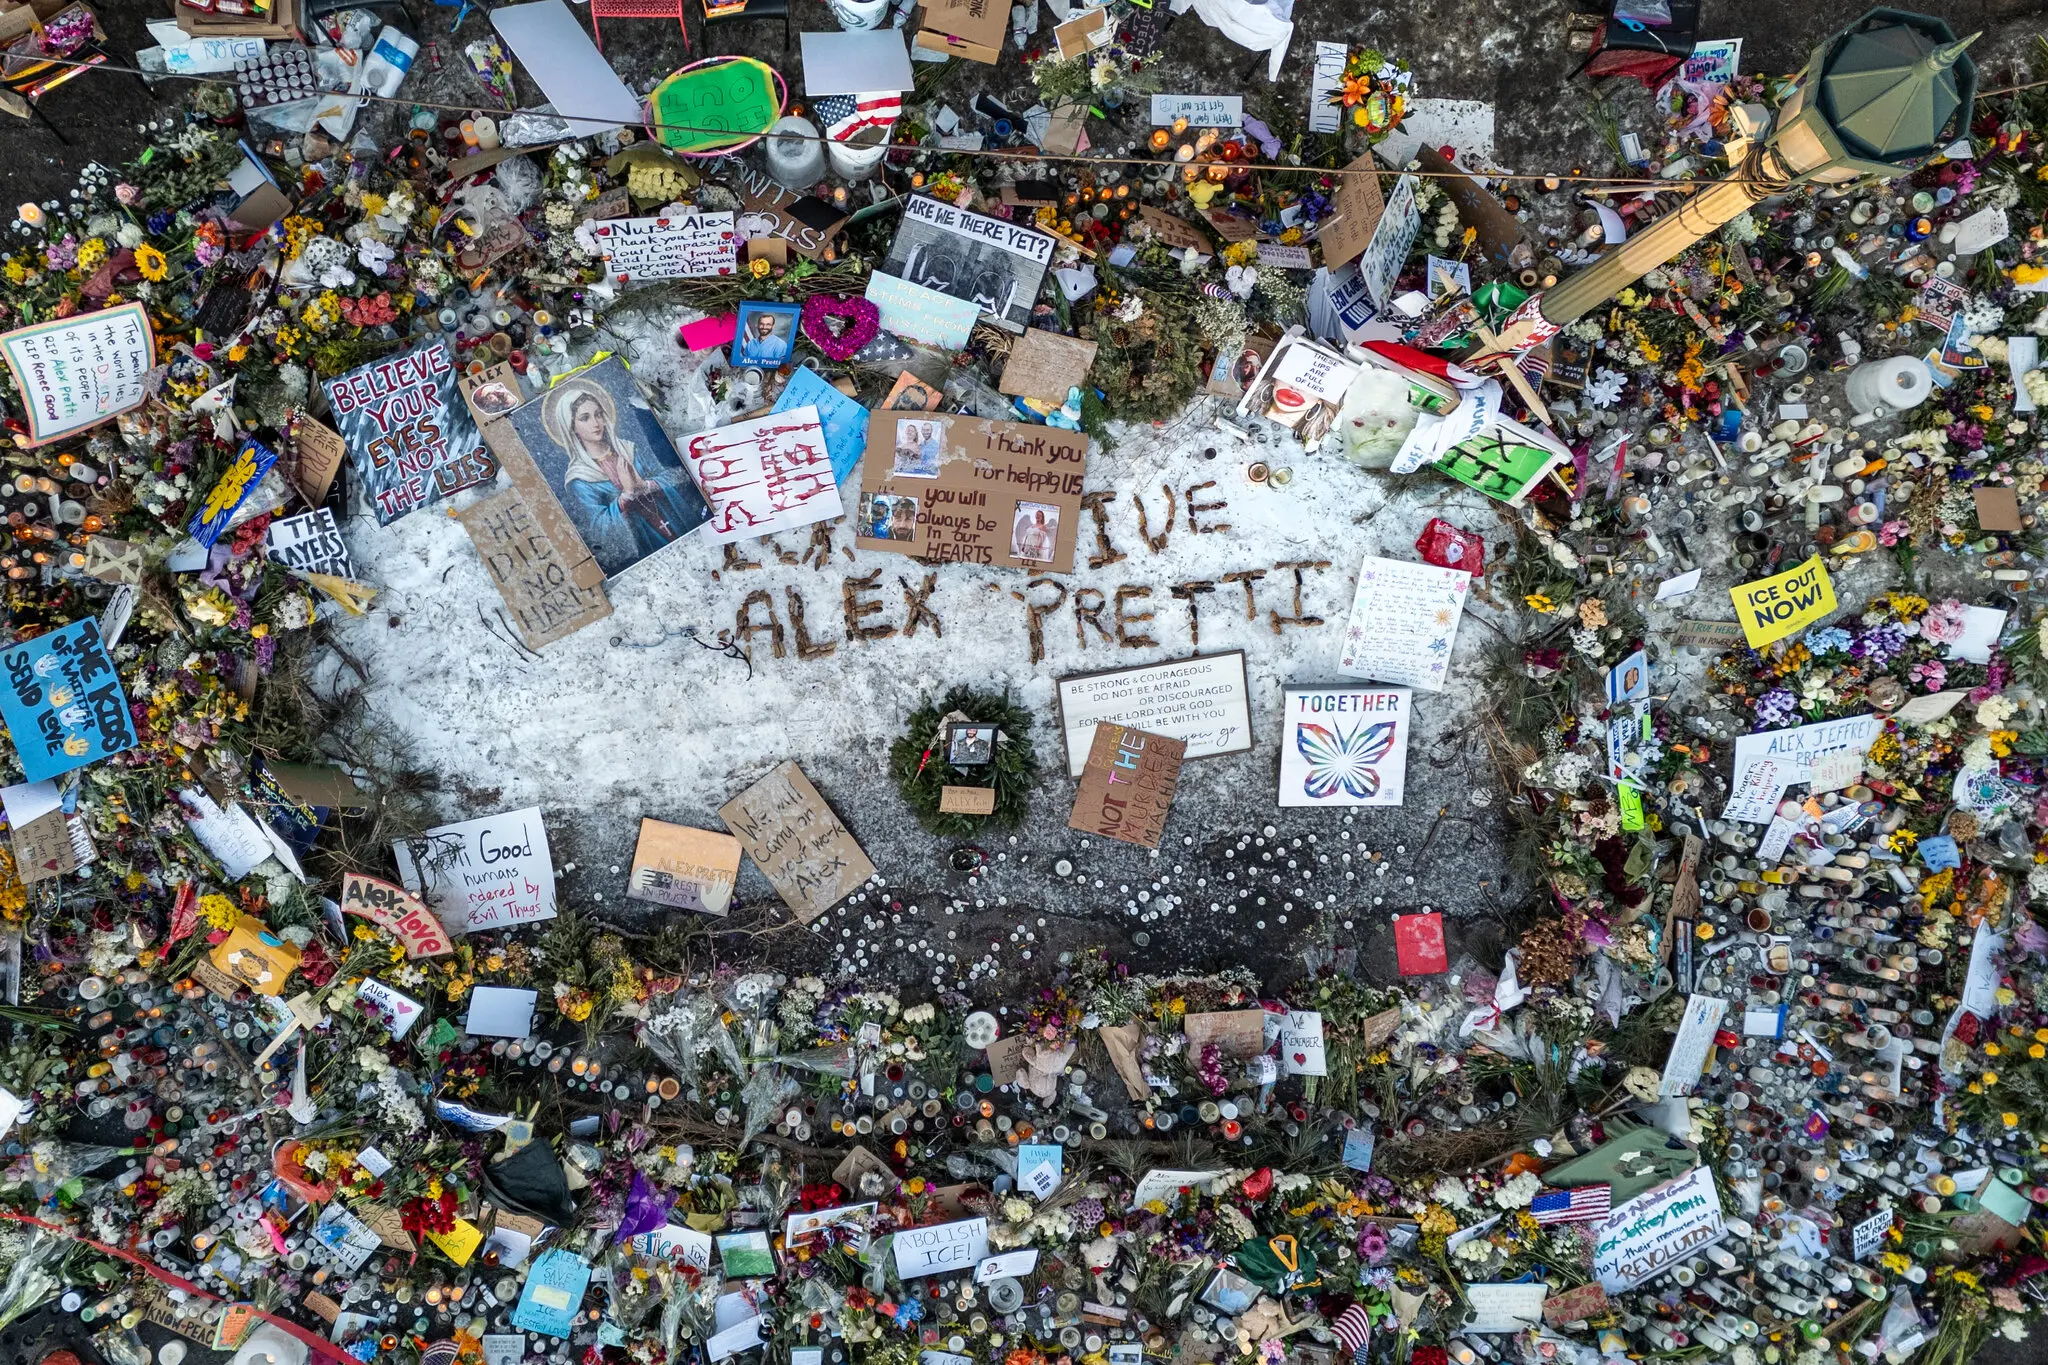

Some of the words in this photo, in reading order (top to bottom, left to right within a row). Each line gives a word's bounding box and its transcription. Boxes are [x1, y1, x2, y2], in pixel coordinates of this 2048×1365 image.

[203, 41, 227, 60] NO
[660, 76, 755, 117] OUT
[611, 222, 676, 237] Nurse
[680, 215, 733, 231] Alex
[907, 199, 935, 219] ARE
[934, 207, 956, 227] WE
[959, 213, 1006, 241] THERE
[1008, 228, 1050, 260] YET?
[602, 236, 658, 247] Thank
[661, 235, 685, 245] you
[607, 246, 645, 258] Your
[610, 256, 640, 265] and
[647, 252, 683, 262] Love
[611, 261, 680, 273] Everyone
[638, 267, 687, 278] Cared
[867, 287, 922, 312] STEMS
[896, 283, 957, 308] PEACE
[1931, 280, 1948, 299] ICE
[122, 318, 140, 346] The
[42, 335, 59, 355] RIP
[51, 358, 69, 383] Alex
[91, 344, 105, 363] the
[104, 324, 117, 347] the
[113, 351, 127, 379] world
[742, 357, 758, 366] Alex
[761, 358, 782, 367] Pretti
[1313, 352, 1340, 367] THESE
[1944, 349, 1963, 364] ICE
[1964, 356, 1983, 366] NO
[467, 365, 504, 391] ALEX
[1303, 372, 1323, 385] FULL
[1309, 368, 1327, 378] ARE
[1312, 360, 1331, 372] LIPS
[21, 338, 41, 361] RIP
[31, 362, 51, 392] Renee
[43, 393, 60, 421] Good
[331, 345, 451, 416] BELIEVE
[1295, 376, 1307, 387] OF
[1306, 382, 1326, 393] LIES
[364, 381, 442, 434] YOUR
[313, 425, 329, 449] ARE
[325, 435, 341, 457] WE
[367, 414, 441, 470] EYES
[987, 432, 1046, 458] Thank
[1050, 444, 1083, 465] you
[397, 438, 449, 481] NOT
[753, 425, 794, 515] KILLING
[376, 476, 427, 517] THE
[432, 446, 495, 495] LIES
[688, 432, 760, 535] STOP
[1007, 463, 1060, 494] helppig
[1062, 474, 1085, 497] US
[925, 487, 956, 509] you
[958, 490, 987, 507] will
[283, 510, 336, 539] THE
[484, 502, 531, 544] HE
[916, 510, 971, 534] always
[976, 514, 998, 532] be
[953, 530, 981, 544] our
[926, 541, 993, 566] HEARTS
[524, 562, 566, 599] NO
[1747, 585, 1781, 607] ICE
[1784, 566, 1817, 593] OUT
[734, 567, 942, 660] ALEX
[1010, 560, 1333, 666] PRETTI
[1753, 583, 1824, 629] NOW!
[1677, 635, 1697, 645] REST
[1707, 636, 1731, 646] POWER
[1681, 622, 1689, 633] A
[1692, 622, 1713, 634] TRUE
[1714, 624, 1739, 635] HERO
[52, 634, 73, 657] OF
[72, 620, 111, 684] THE
[1071, 685, 1085, 695] BE
[1087, 677, 1131, 693] STRONG
[1139, 664, 1213, 684] COURAGEOUS
[1093, 692, 1110, 702] DO
[1111, 688, 1134, 700] NOT
[1137, 685, 1151, 695] BE
[1152, 679, 1192, 693] AFRAID
[4, 650, 43, 707] SEND
[37, 708, 66, 757] LOVE
[1139, 696, 1155, 706] OR
[1157, 684, 1234, 704] DISCOURAGED
[1298, 694, 1400, 713] TOGETHER
[87, 681, 133, 753] KIDS
[1078, 717, 1100, 729] FOR
[1126, 708, 1155, 720] LORD
[1156, 704, 1187, 715] YOUR
[1189, 698, 1214, 711] GOD
[1127, 721, 1153, 731] WILL
[1155, 717, 1169, 728] BE
[1171, 712, 1201, 725] WITH
[1202, 707, 1227, 719] YOU
[1217, 725, 1241, 748] go
[1767, 732, 1805, 755] ALEX
[1811, 719, 1876, 748] JEFFREY
[1108, 731, 1146, 786] THE
[254, 768, 276, 789] LOVE
[1750, 760, 1774, 788] Killing
[1120, 739, 1168, 843] MURDER
[1143, 750, 1184, 844] MACHINE
[1767, 784, 1781, 805] now
[797, 807, 818, 827] on
[1097, 792, 1128, 837] NOT
[1724, 798, 1740, 819] Mr.
[295, 812, 310, 833] ICE
[732, 805, 773, 842] We
[479, 822, 533, 864] Good
[462, 866, 520, 887] humans
[656, 857, 696, 875] ALEX
[524, 876, 540, 901] by
[673, 879, 699, 893] REST
[796, 855, 848, 903] Alex
[346, 879, 405, 914] Alex
[641, 887, 654, 899] IN
[658, 889, 688, 905] POWER
[502, 901, 542, 919] Thugs
[395, 909, 442, 955] Love
[1037, 1174, 1052, 1187] NURSE
[1665, 1173, 1699, 1198] Good
[1620, 1210, 1669, 1242] Jeffrey
[1670, 1194, 1707, 1219] Pretti
[1854, 1221, 1873, 1237] YOU
[1873, 1211, 1890, 1226] DID
[898, 1222, 983, 1252] ABOLISH
[1622, 1238, 1654, 1261] their
[1656, 1219, 1696, 1244] memories
[1695, 1212, 1709, 1223] be
[1854, 1232, 1869, 1245] THE
[1855, 1237, 1880, 1253] THING
[689, 1244, 708, 1268] FOR
[920, 1242, 972, 1268] ICE!
[146, 1305, 182, 1330] KNOW
[535, 1303, 559, 1317] ICE
